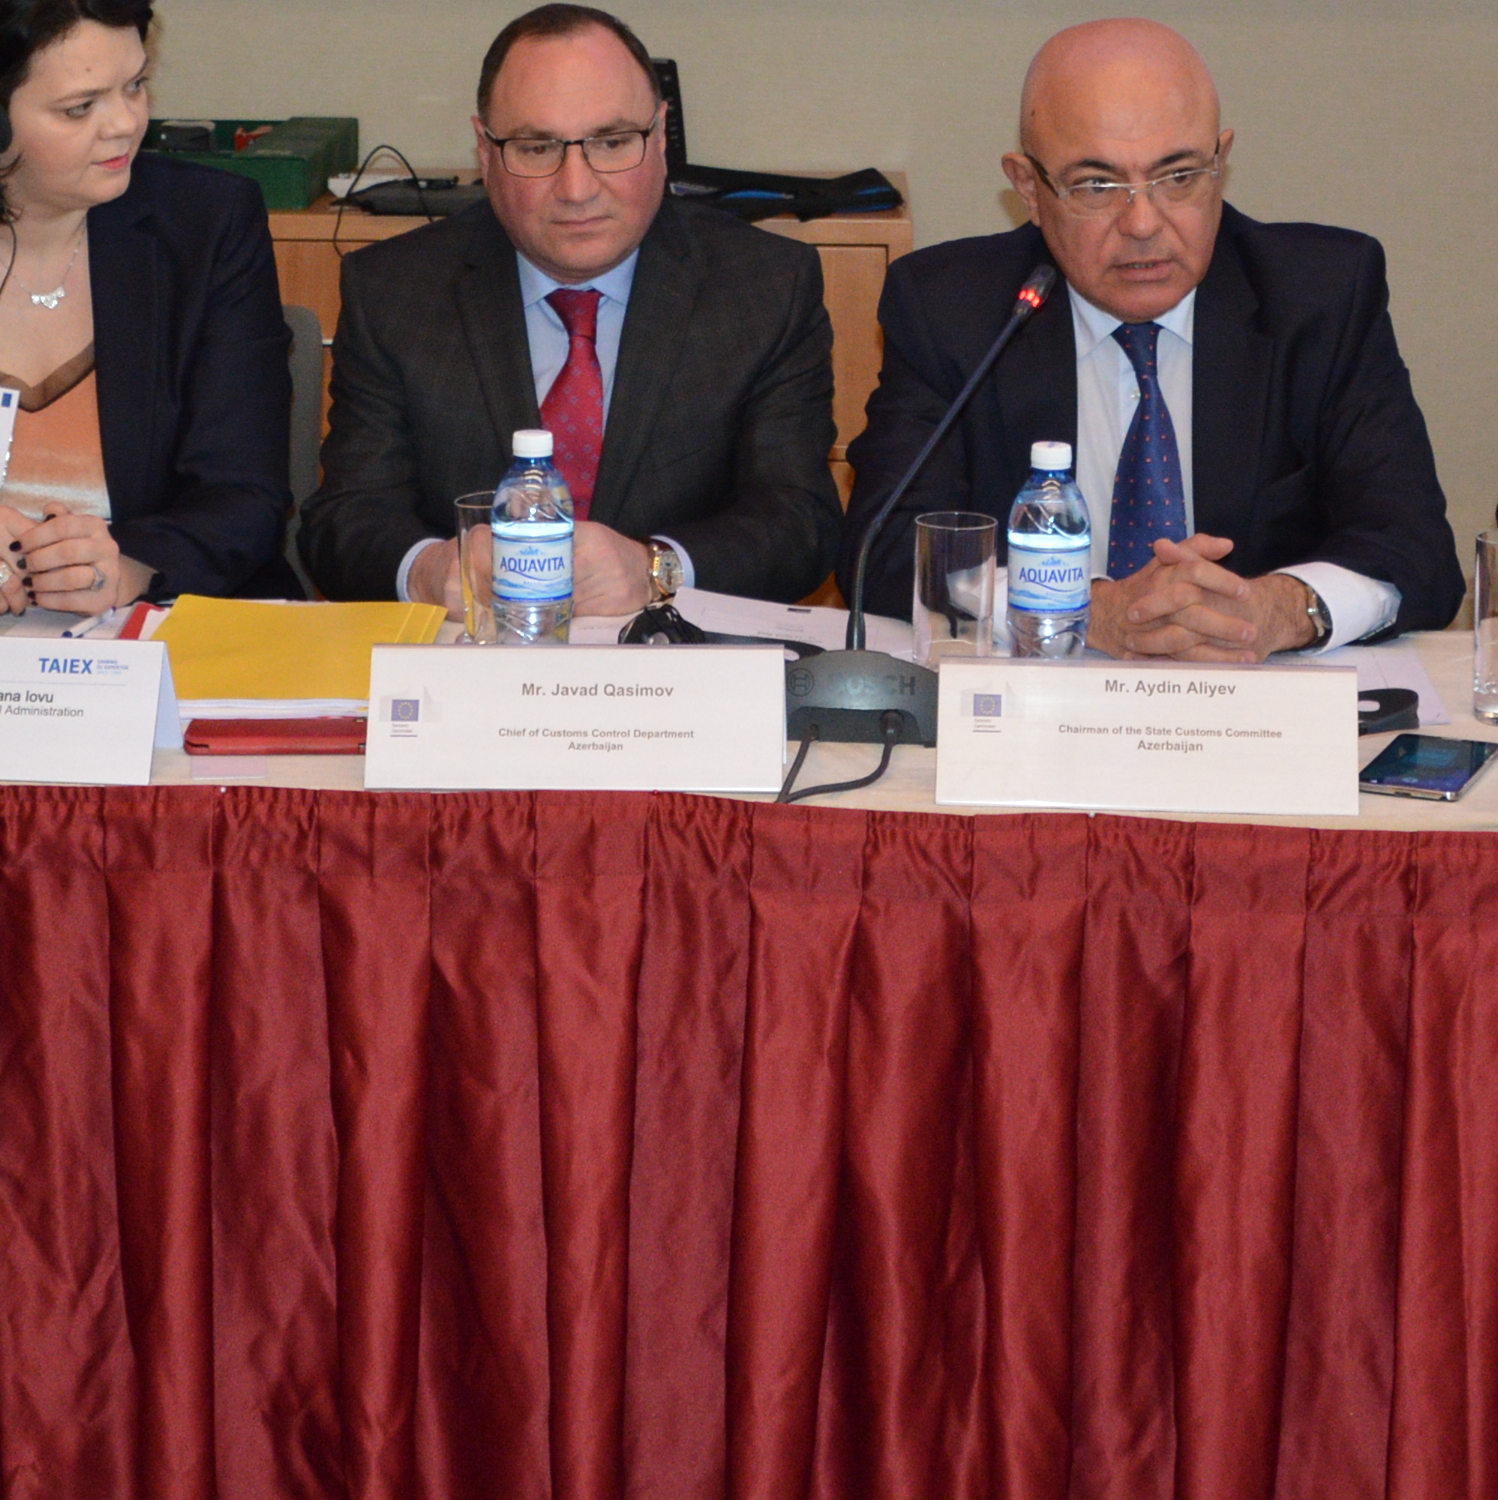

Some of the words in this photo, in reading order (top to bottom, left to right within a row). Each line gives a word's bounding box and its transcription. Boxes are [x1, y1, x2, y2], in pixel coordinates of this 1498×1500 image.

[500, 556, 565, 572] AQUAVITA
[1019, 567, 1084, 583] AQUAVITA
[38, 657, 93, 675] TAIEX
[521, 683, 546, 697] Mr.
[551, 683, 598, 696] Javad
[603, 684, 674, 698] Qasimov
[1105, 679, 1130, 694] Mr.
[1135, 680, 1182, 696] Aydin
[1186, 681, 1236, 697] Aliyev
[25, 690, 54, 703] Iovu
[4, 705, 84, 718] Administration
[498, 728, 526, 738] Chief
[528, 728, 540, 738] of
[542, 729, 588, 738] Customs
[591, 729, 630, 739] Control
[633, 729, 694, 740] Department
[1058, 724, 1109, 735] Chairman
[1112, 725, 1123, 735] of
[1125, 725, 1142, 736] the
[1145, 726, 1172, 736] State
[1175, 727, 1222, 738] Customs
[1225, 728, 1283, 739] Committee
[568, 741, 623, 752] Azerbaijan
[1137, 739, 1204, 753] Azerbaijan
